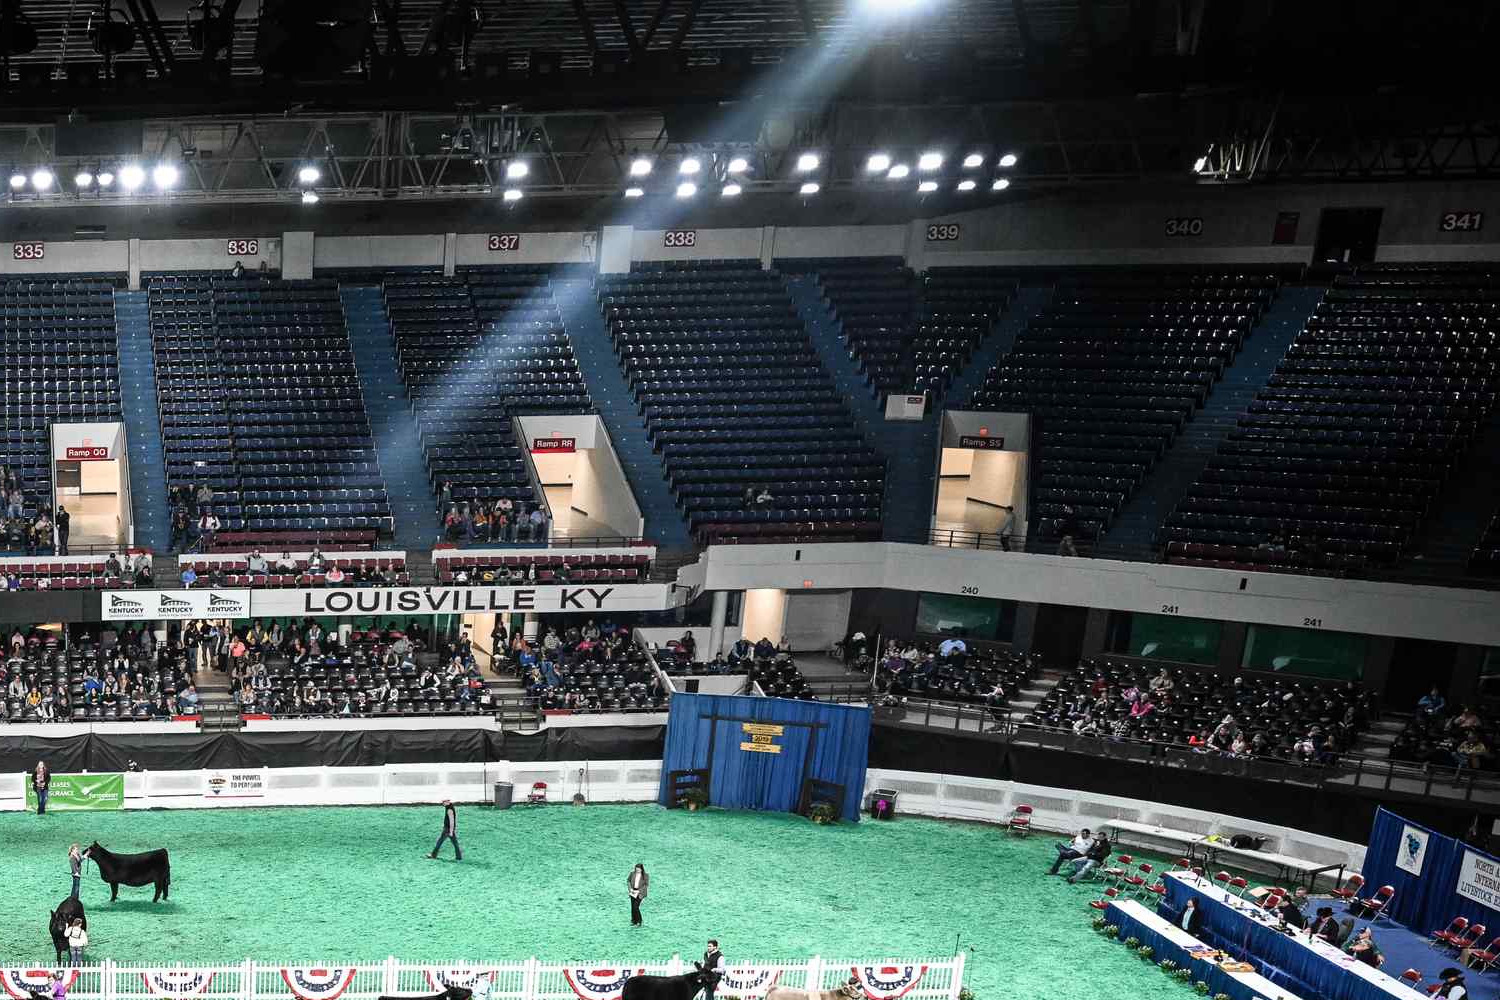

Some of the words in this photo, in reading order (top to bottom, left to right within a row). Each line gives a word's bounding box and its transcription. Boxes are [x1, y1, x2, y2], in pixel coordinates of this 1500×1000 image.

[1166, 218, 1203, 236] 340
[1443, 213, 1482, 231] 341
[665, 231, 695, 246] 338
[928, 225, 959, 240] 339
[228, 240, 258, 255] 336
[490, 235, 519, 250] 337
[14, 243, 44, 259] 335
[536, 440, 559, 449] Ramp
[963, 439, 986, 448] Ramp
[69, 449, 90, 458] Ramp
[961, 586, 979, 595] 240
[305, 589, 536, 612] LOUISVILLE
[560, 588, 614, 609] KY
[1162, 605, 1179, 614] 241
[1304, 617, 1322, 627] 241
[1475, 859, 1494, 874] NORTH
[1461, 881, 1493, 903] LIVESTOCK
